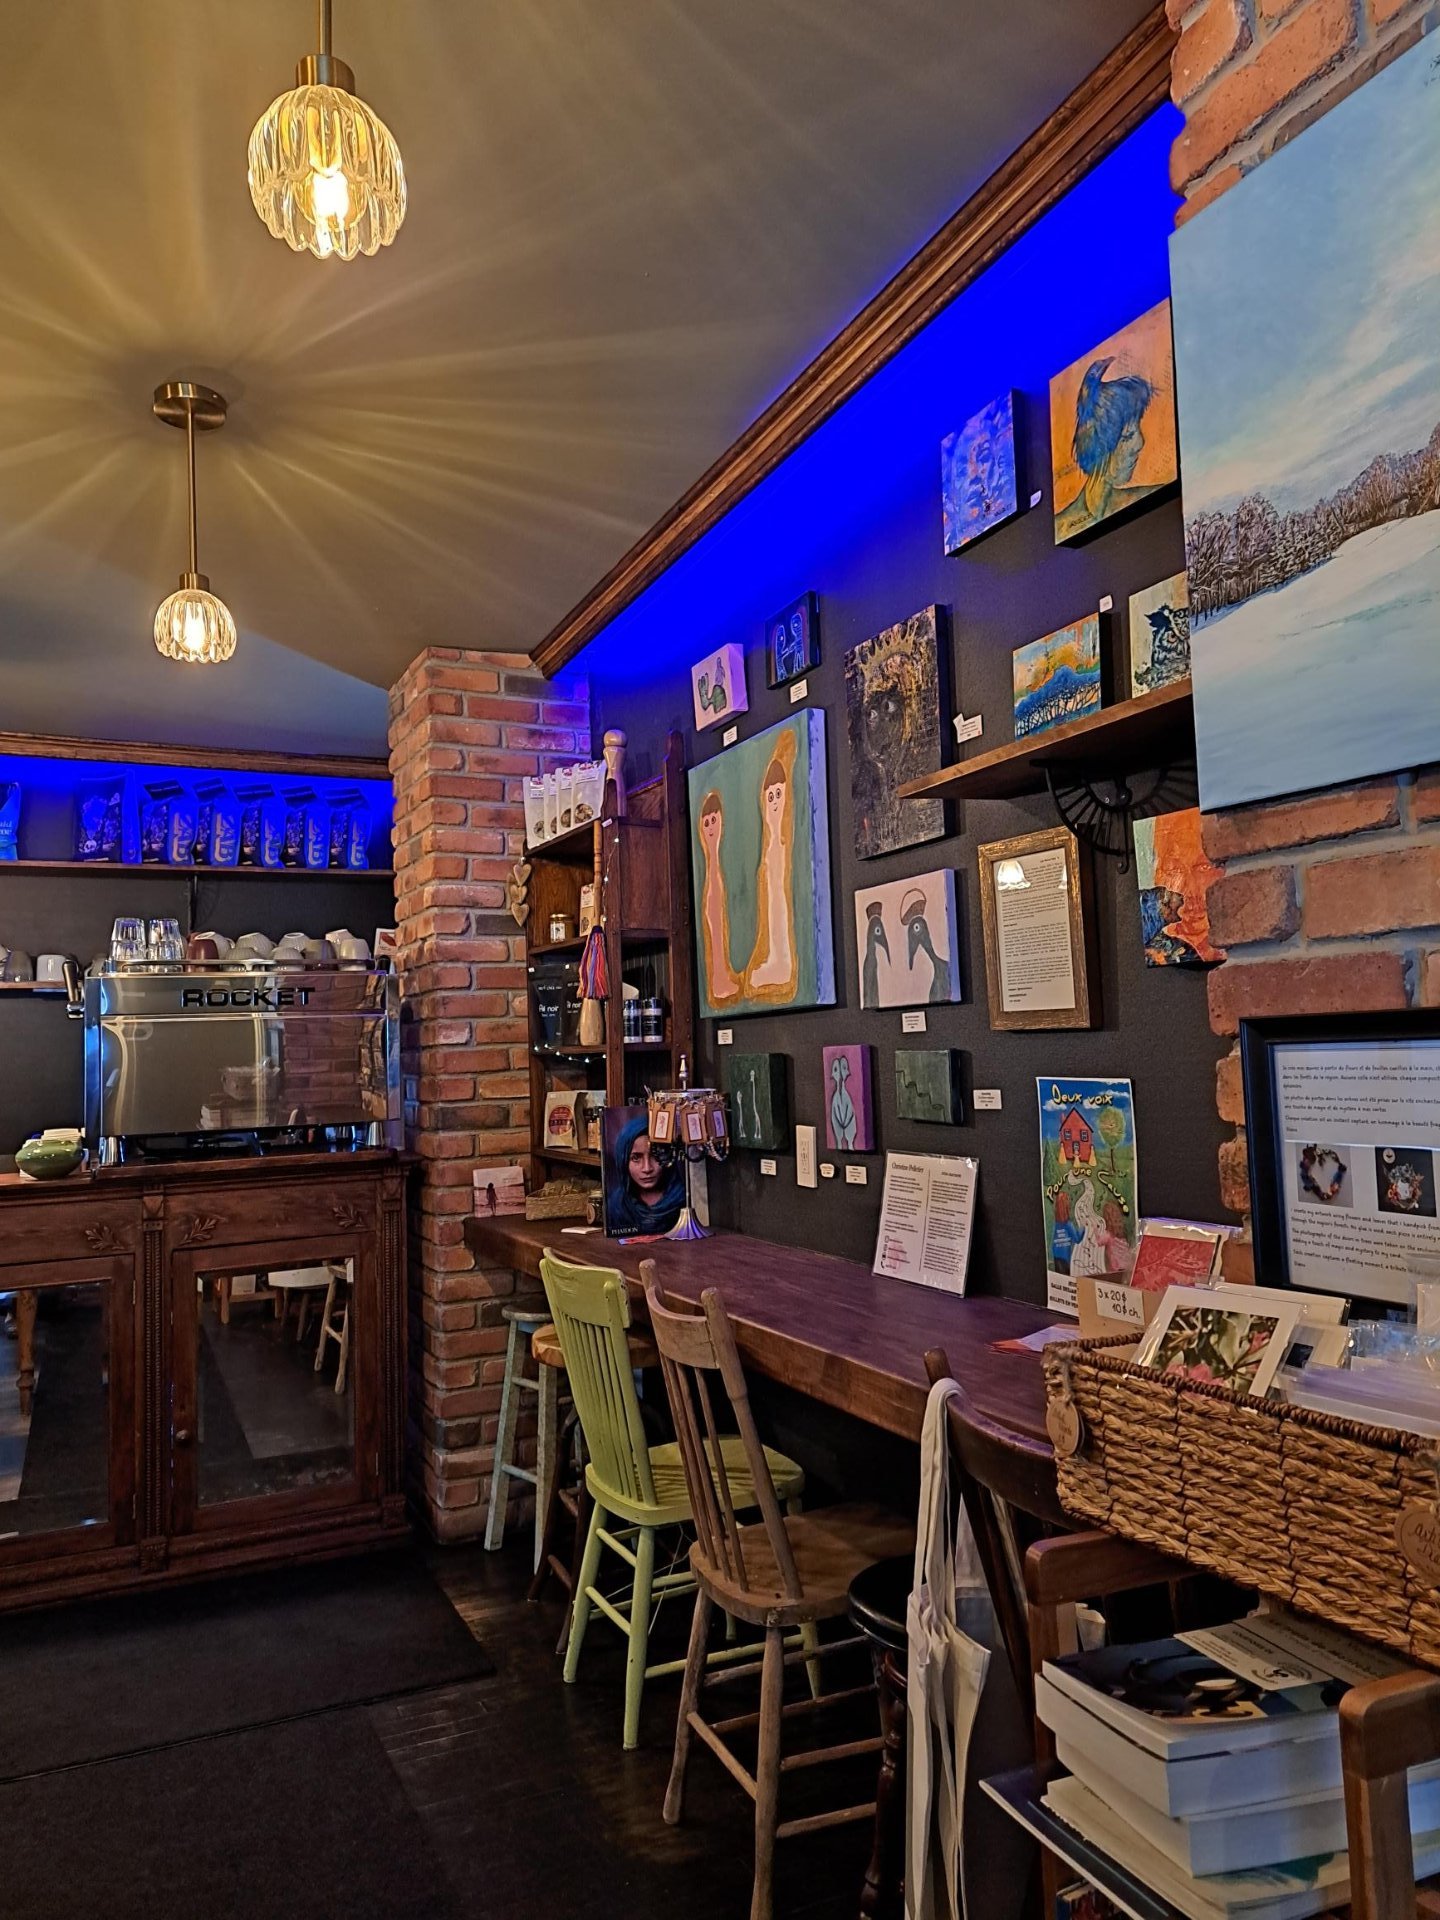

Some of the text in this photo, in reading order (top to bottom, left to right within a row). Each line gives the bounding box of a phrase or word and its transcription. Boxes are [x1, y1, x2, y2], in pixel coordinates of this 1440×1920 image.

[181, 986, 316, 1008] ROCKET
[547, 1005, 559, 1013] noir
[1052, 1083, 1114, 1106] Deux voix
[1333, 1232, 1341, 1240] the
[1110, 1290, 1128, 1302] 20$
[1112, 1303, 1128, 1315] 10$
